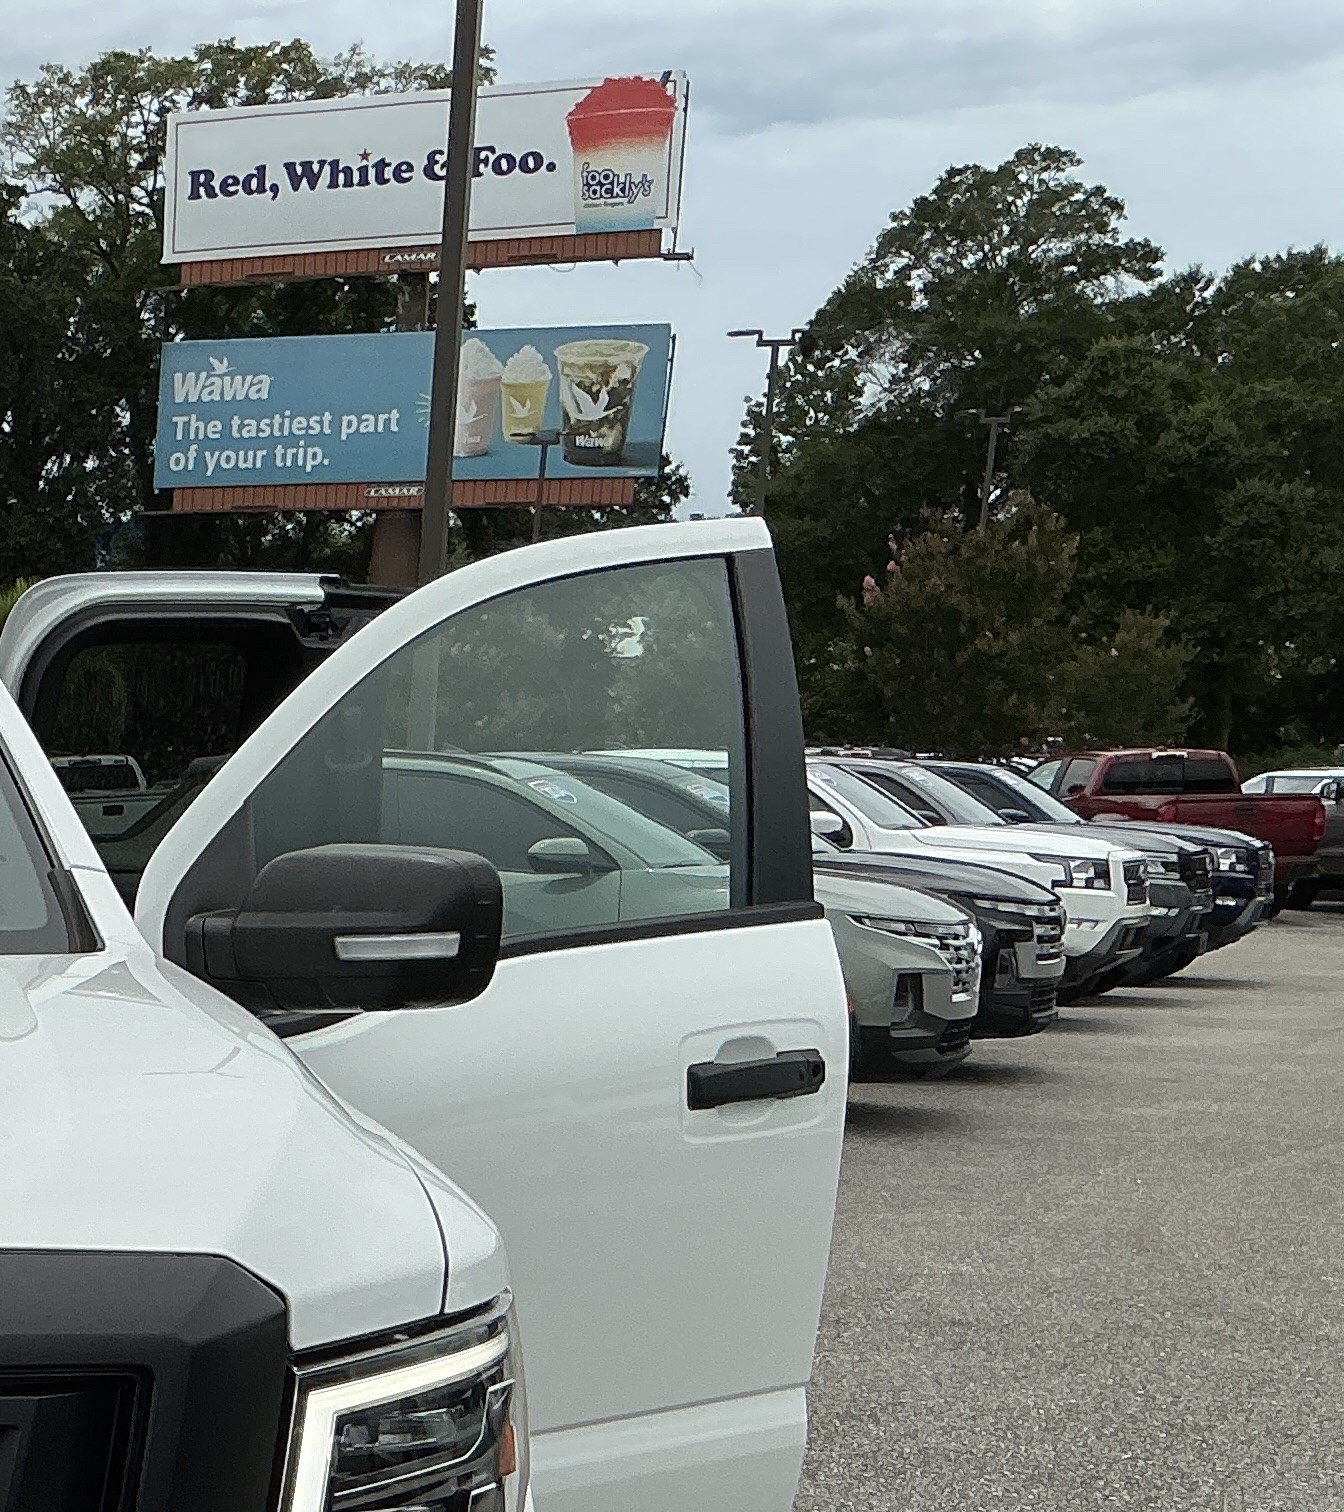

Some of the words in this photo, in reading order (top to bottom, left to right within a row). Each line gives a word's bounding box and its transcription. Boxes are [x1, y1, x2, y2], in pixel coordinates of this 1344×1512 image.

[187, 165, 280, 201] Red,
[283, 148, 415, 192] White
[471, 146, 557, 179] Foo.
[580, 173, 654, 205] sackly's
[581, 161, 615, 186] foo
[383, 252, 437, 263] LAMAR
[173, 373, 272, 403] Wawa
[172, 414, 223, 441] The
[230, 410, 332, 439] tastiest
[340, 408, 400, 441] part
[169, 444, 199, 471] of
[204, 449, 268, 476] your
[274, 440, 330, 473] trip.
[368, 487, 420, 497] LAMAR
